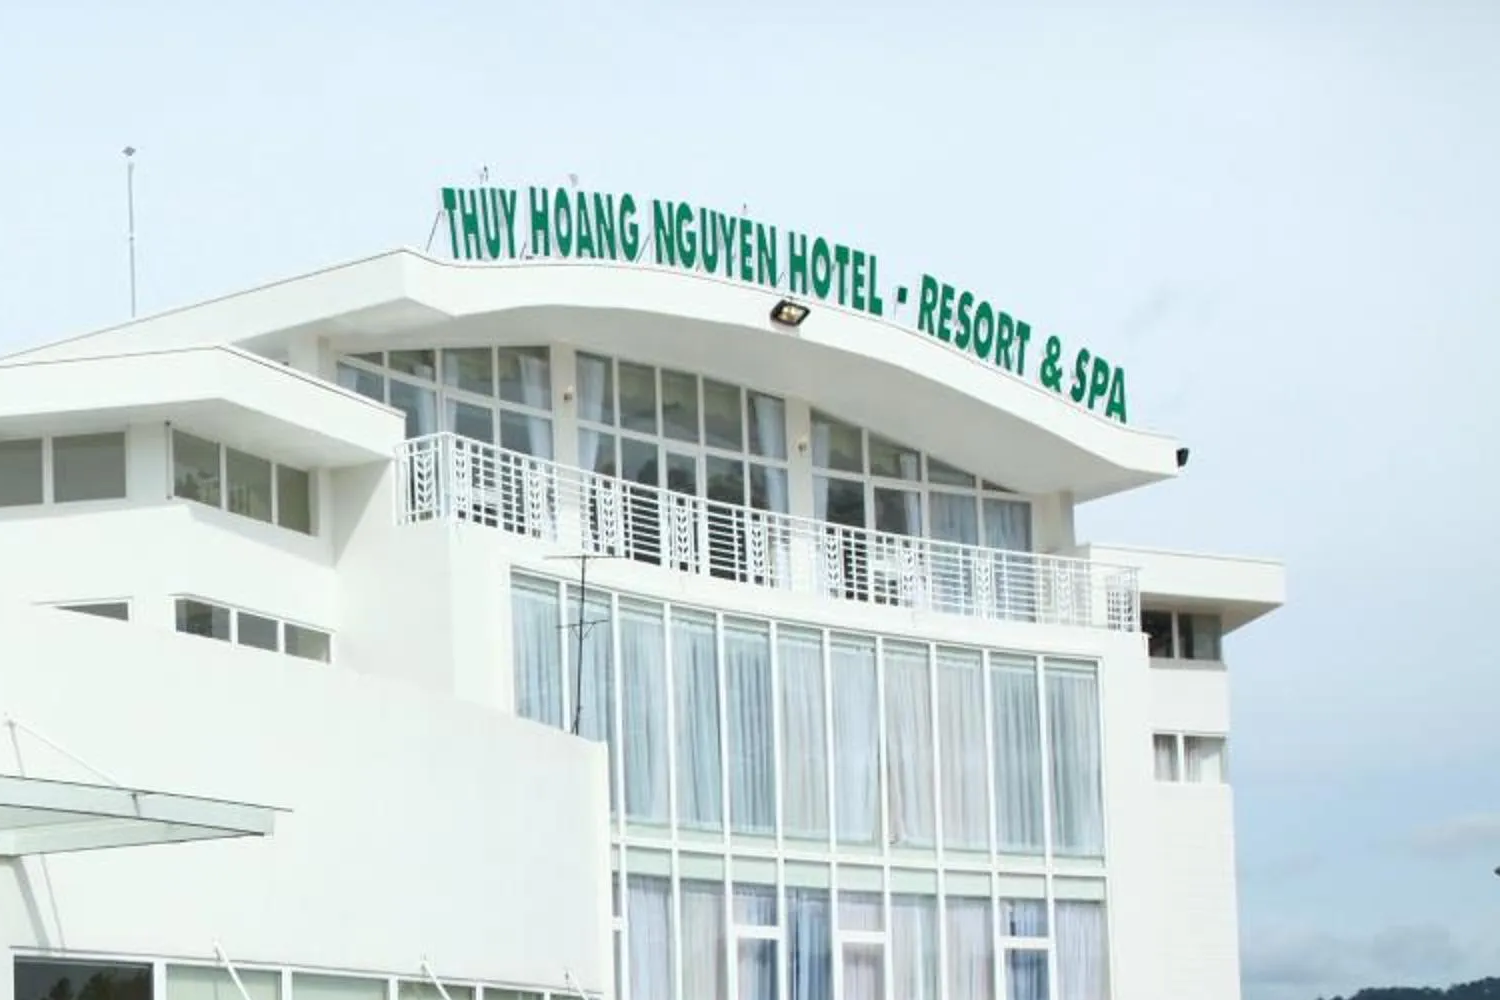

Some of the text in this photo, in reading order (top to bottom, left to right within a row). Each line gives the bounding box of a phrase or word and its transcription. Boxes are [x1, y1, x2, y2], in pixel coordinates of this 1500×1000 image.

[788, 231, 884, 316] HOTEL
[917, 273, 1032, 376] RESORT
[1039, 334, 1064, 393] &
[1070, 347, 1128, 424] SPA
